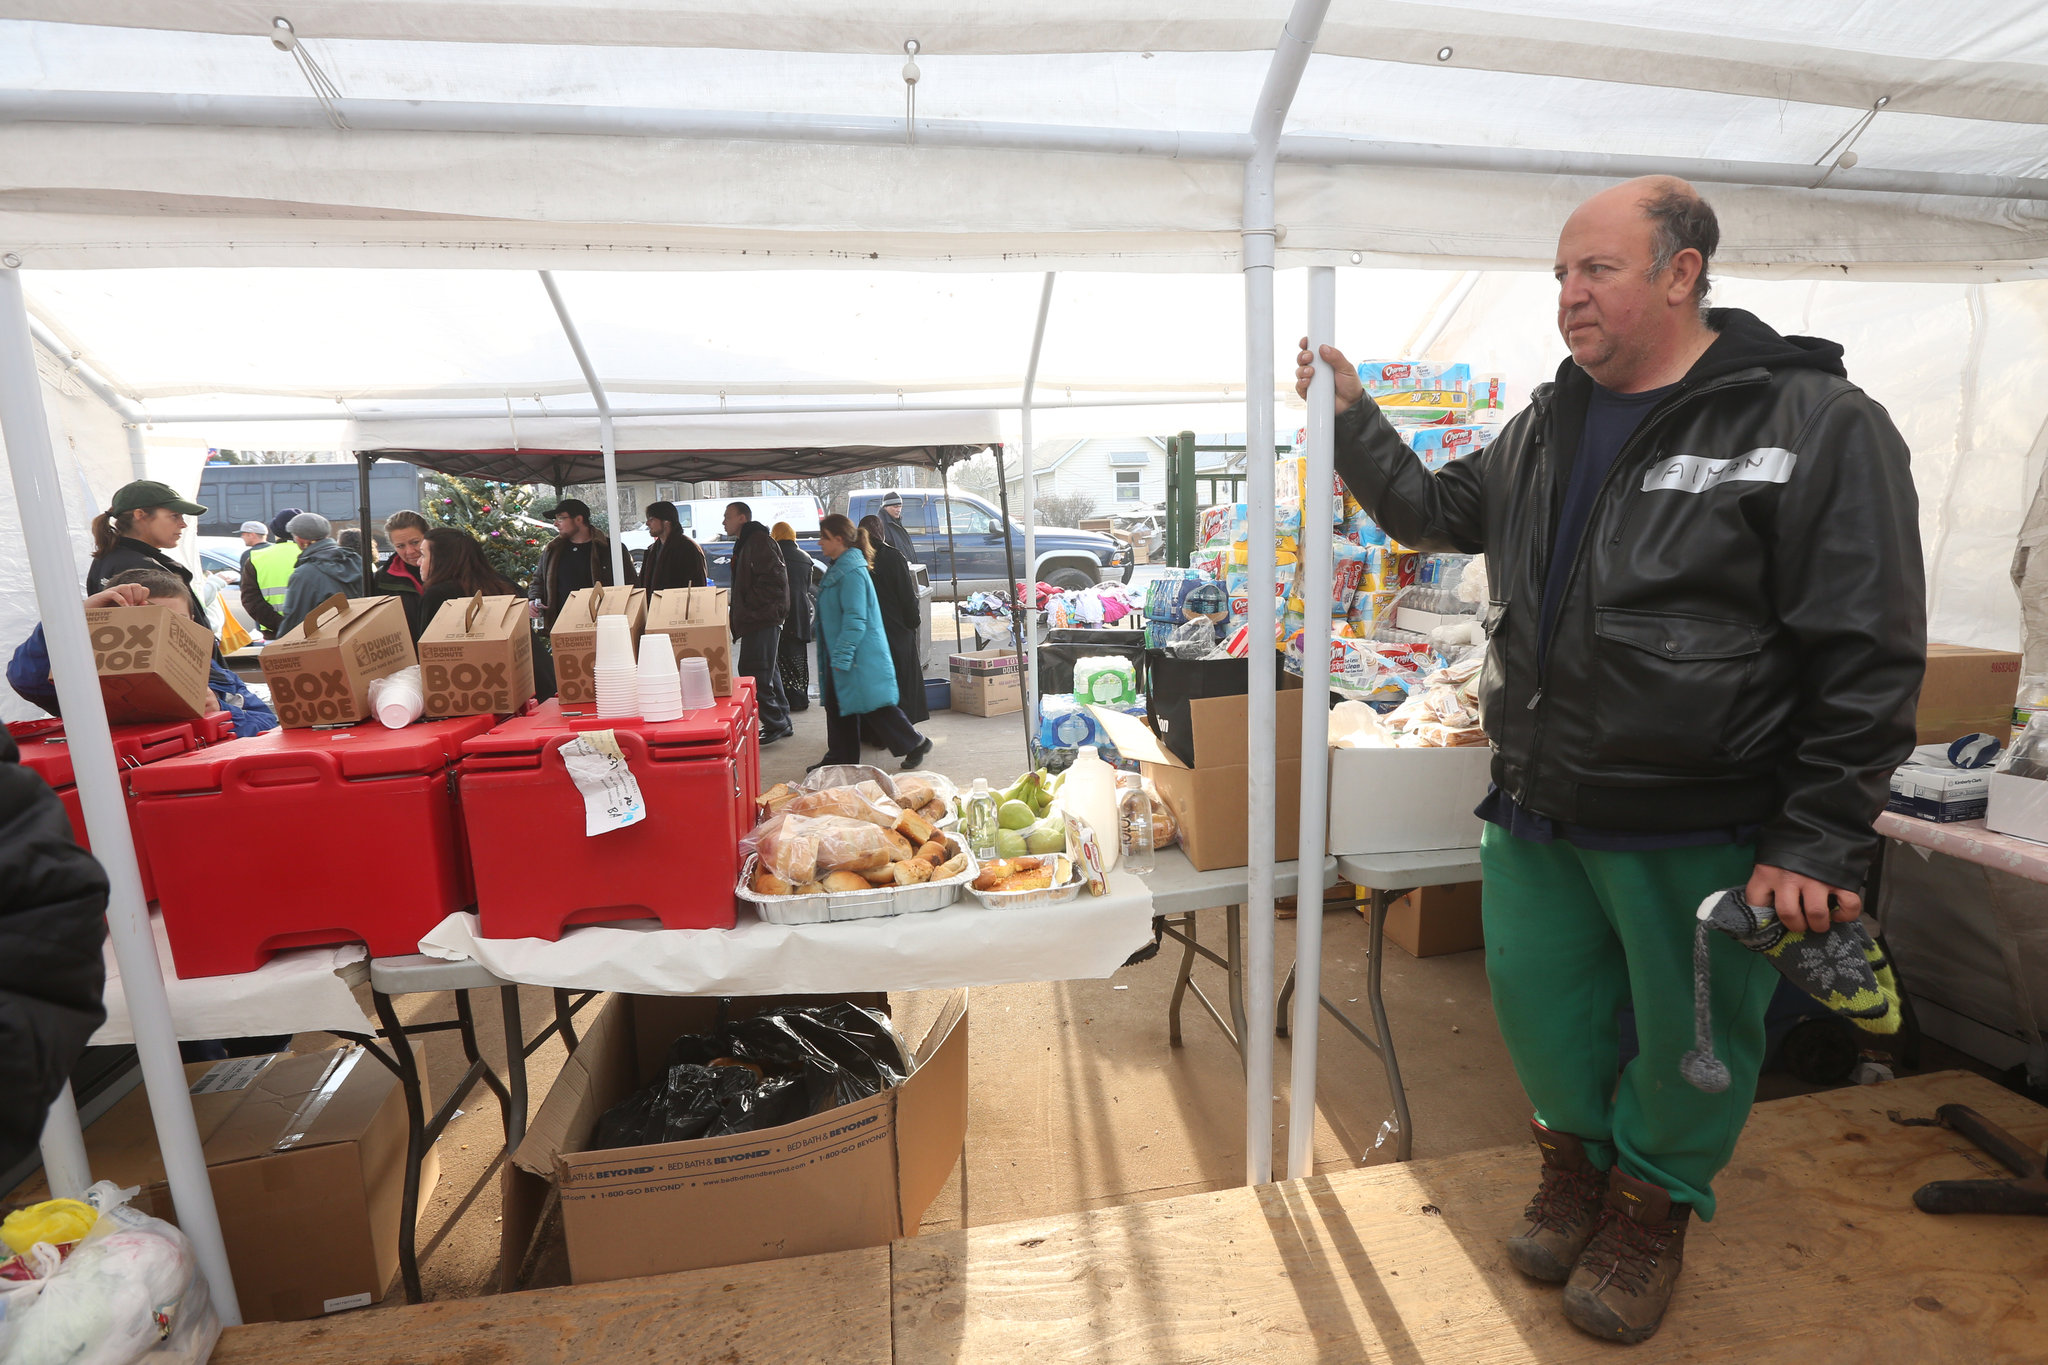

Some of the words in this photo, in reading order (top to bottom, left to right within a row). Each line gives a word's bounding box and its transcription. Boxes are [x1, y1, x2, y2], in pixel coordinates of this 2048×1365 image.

[1410, 393, 1421, 403] 30
[1431, 393, 1441, 402] 75
[91, 624, 155, 652] OX
[370, 642, 404, 662] DONUTS
[270, 669, 349, 703] BOX
[425, 662, 508, 692] BOX
[280, 697, 355, 725] O'JOE
[426, 690, 509, 714] O'JOE
[588, 1171, 595, 1180] &
[596, 1166, 654, 1180] BEYOND
[668, 1162, 684, 1171] BED
[685, 1158, 706, 1168] BATH
[706, 1158, 713, 1166] &
[714, 1149, 771, 1165] BEYOND
[787, 1141, 802, 1152] BED
[803, 1135, 822, 1148] BATH
[823, 1132, 829, 1141] &
[829, 1115, 878, 1138] BEYOND
[703, 1162, 806, 1187] www.bedbathandbeyond.com
